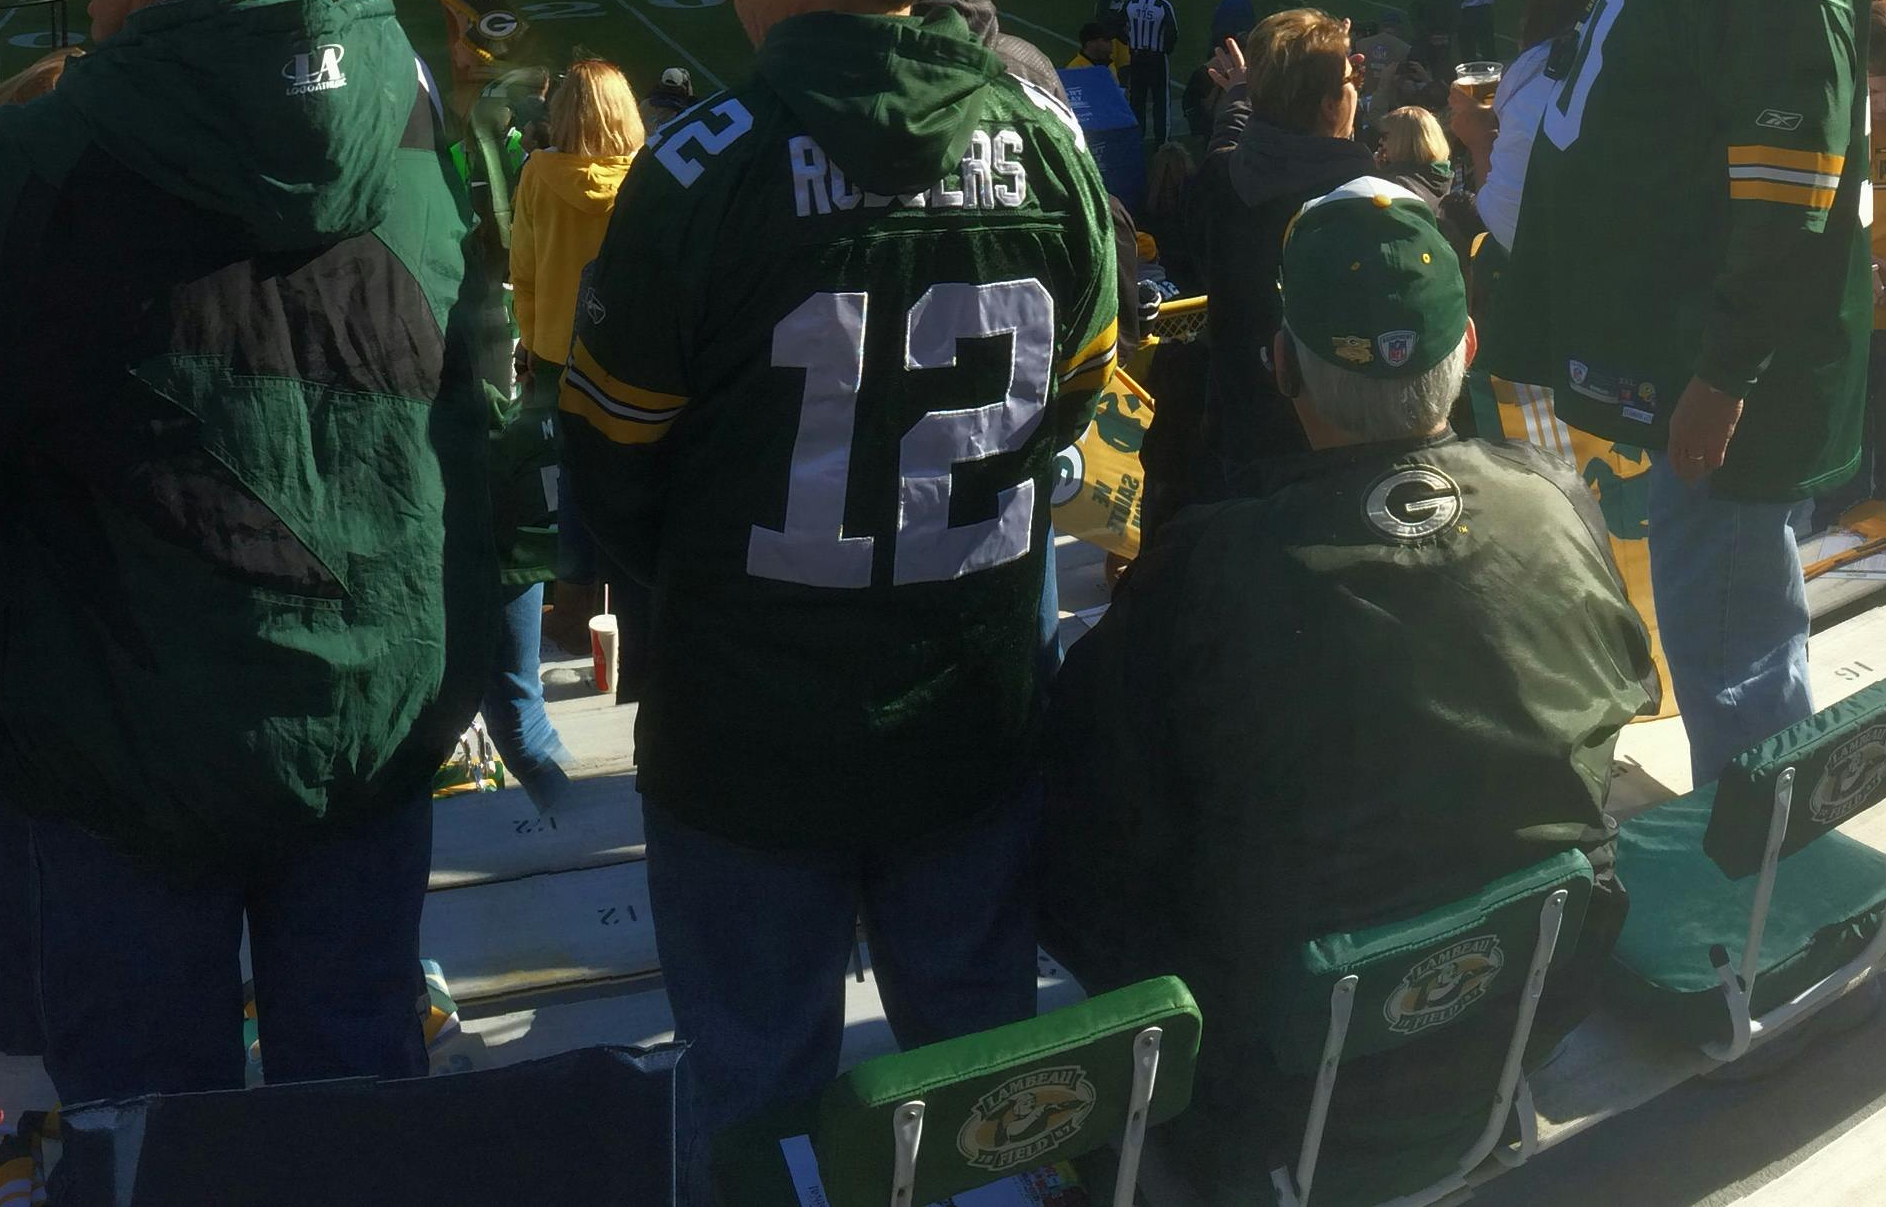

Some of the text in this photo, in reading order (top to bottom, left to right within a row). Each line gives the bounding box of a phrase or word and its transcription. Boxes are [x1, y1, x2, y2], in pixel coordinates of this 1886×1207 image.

[746, 278, 1055, 589] 12
[1417, 942, 1490, 978] LAMBEAU
[1412, 1004, 1461, 1028] FIELD
[985, 1071, 1073, 1109] LAMBEAU
[1000, 1139, 1049, 1166] FIELD
